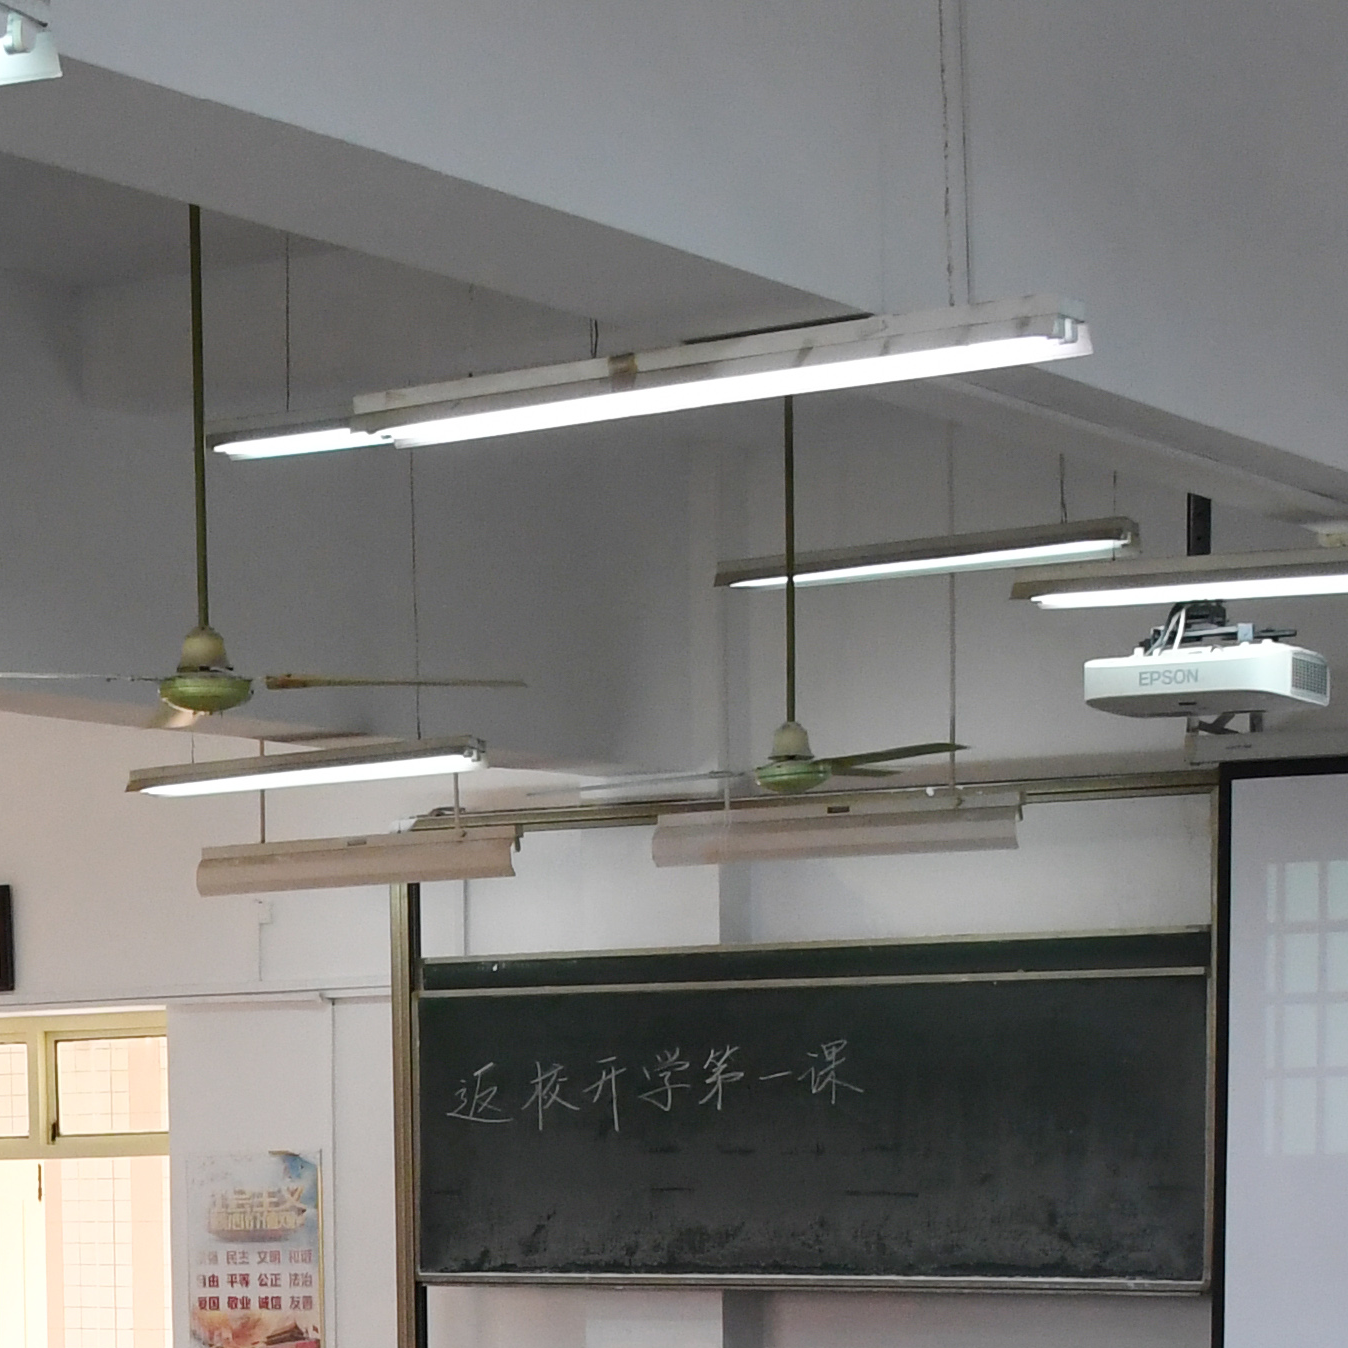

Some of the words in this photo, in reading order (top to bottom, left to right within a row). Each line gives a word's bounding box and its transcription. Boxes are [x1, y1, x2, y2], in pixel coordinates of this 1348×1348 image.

[1138, 668, 1199, 686] EPSON
[447, 1038, 865, 1132] 返校开学第一课
[226, 1250, 250, 1265] 民主
[257, 1250, 281, 1265] 文明
[227, 1273, 251, 1288] 平等
[257, 1273, 282, 1288] 公正
[289, 1272, 313, 1288] 法治
[198, 1296, 220, 1311] 爱国
[227, 1296, 251, 1311] 敬业
[258, 1296, 282, 1311] 诚信
